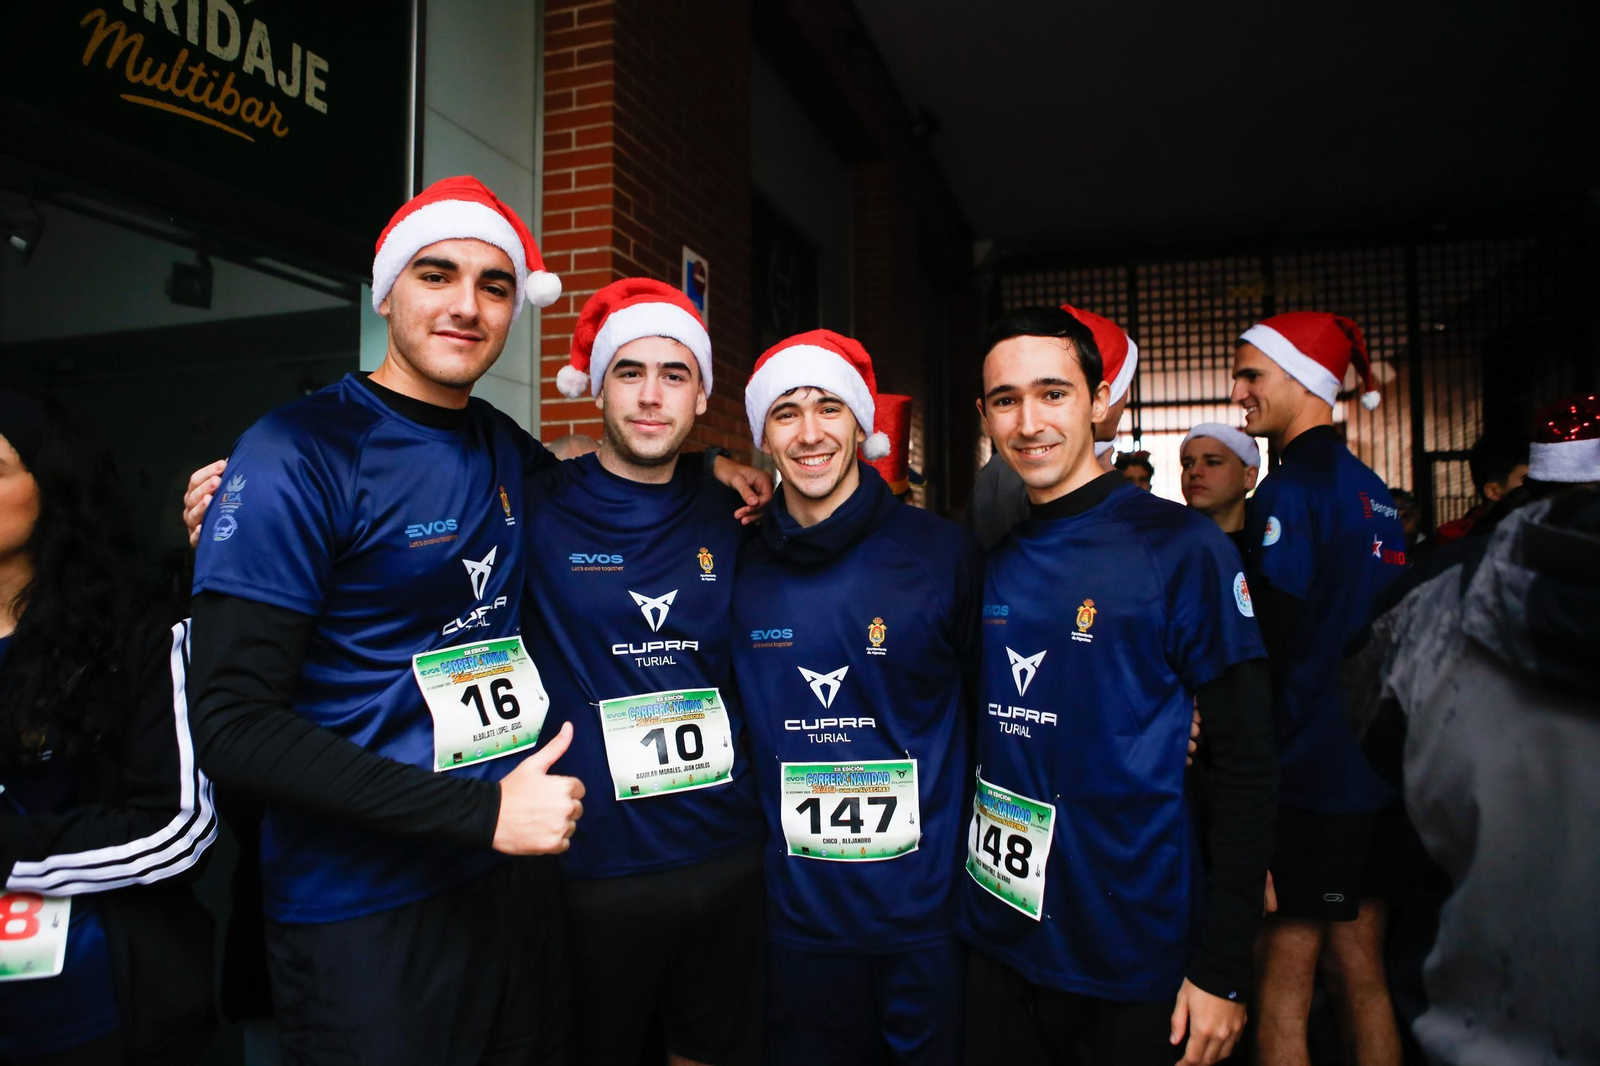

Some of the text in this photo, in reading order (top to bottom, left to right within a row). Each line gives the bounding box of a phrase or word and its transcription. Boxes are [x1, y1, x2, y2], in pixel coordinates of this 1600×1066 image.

[80, 8, 289, 138] Multibar
[405, 518, 459, 538] EVOS
[569, 553, 624, 564] EVOS
[750, 628, 794, 641] EVOS
[612, 640, 699, 656] CUPRA
[440, 655, 481, 679] CARRERA
[635, 655, 677, 668] TURIAL
[460, 677, 521, 728] 16
[628, 699, 704, 721] CARRERA NAVIDAD
[784, 717, 876, 731] CUPRA
[988, 702, 1058, 727] CUPRA
[807, 732, 852, 744] TURIAL
[999, 721, 1032, 739] TURIAL
[640, 723, 705, 765] 10
[658, 766, 682, 776] MORALES,
[682, 764, 695, 772] JUAN
[695, 762, 711, 770] CARLOS
[806, 772, 849, 787] CARRERA
[849, 772, 891, 786] NAVIDAD
[795, 796, 898, 834] 147
[998, 801, 1031, 825] NAVIDAD
[975, 812, 1033, 879] 148
